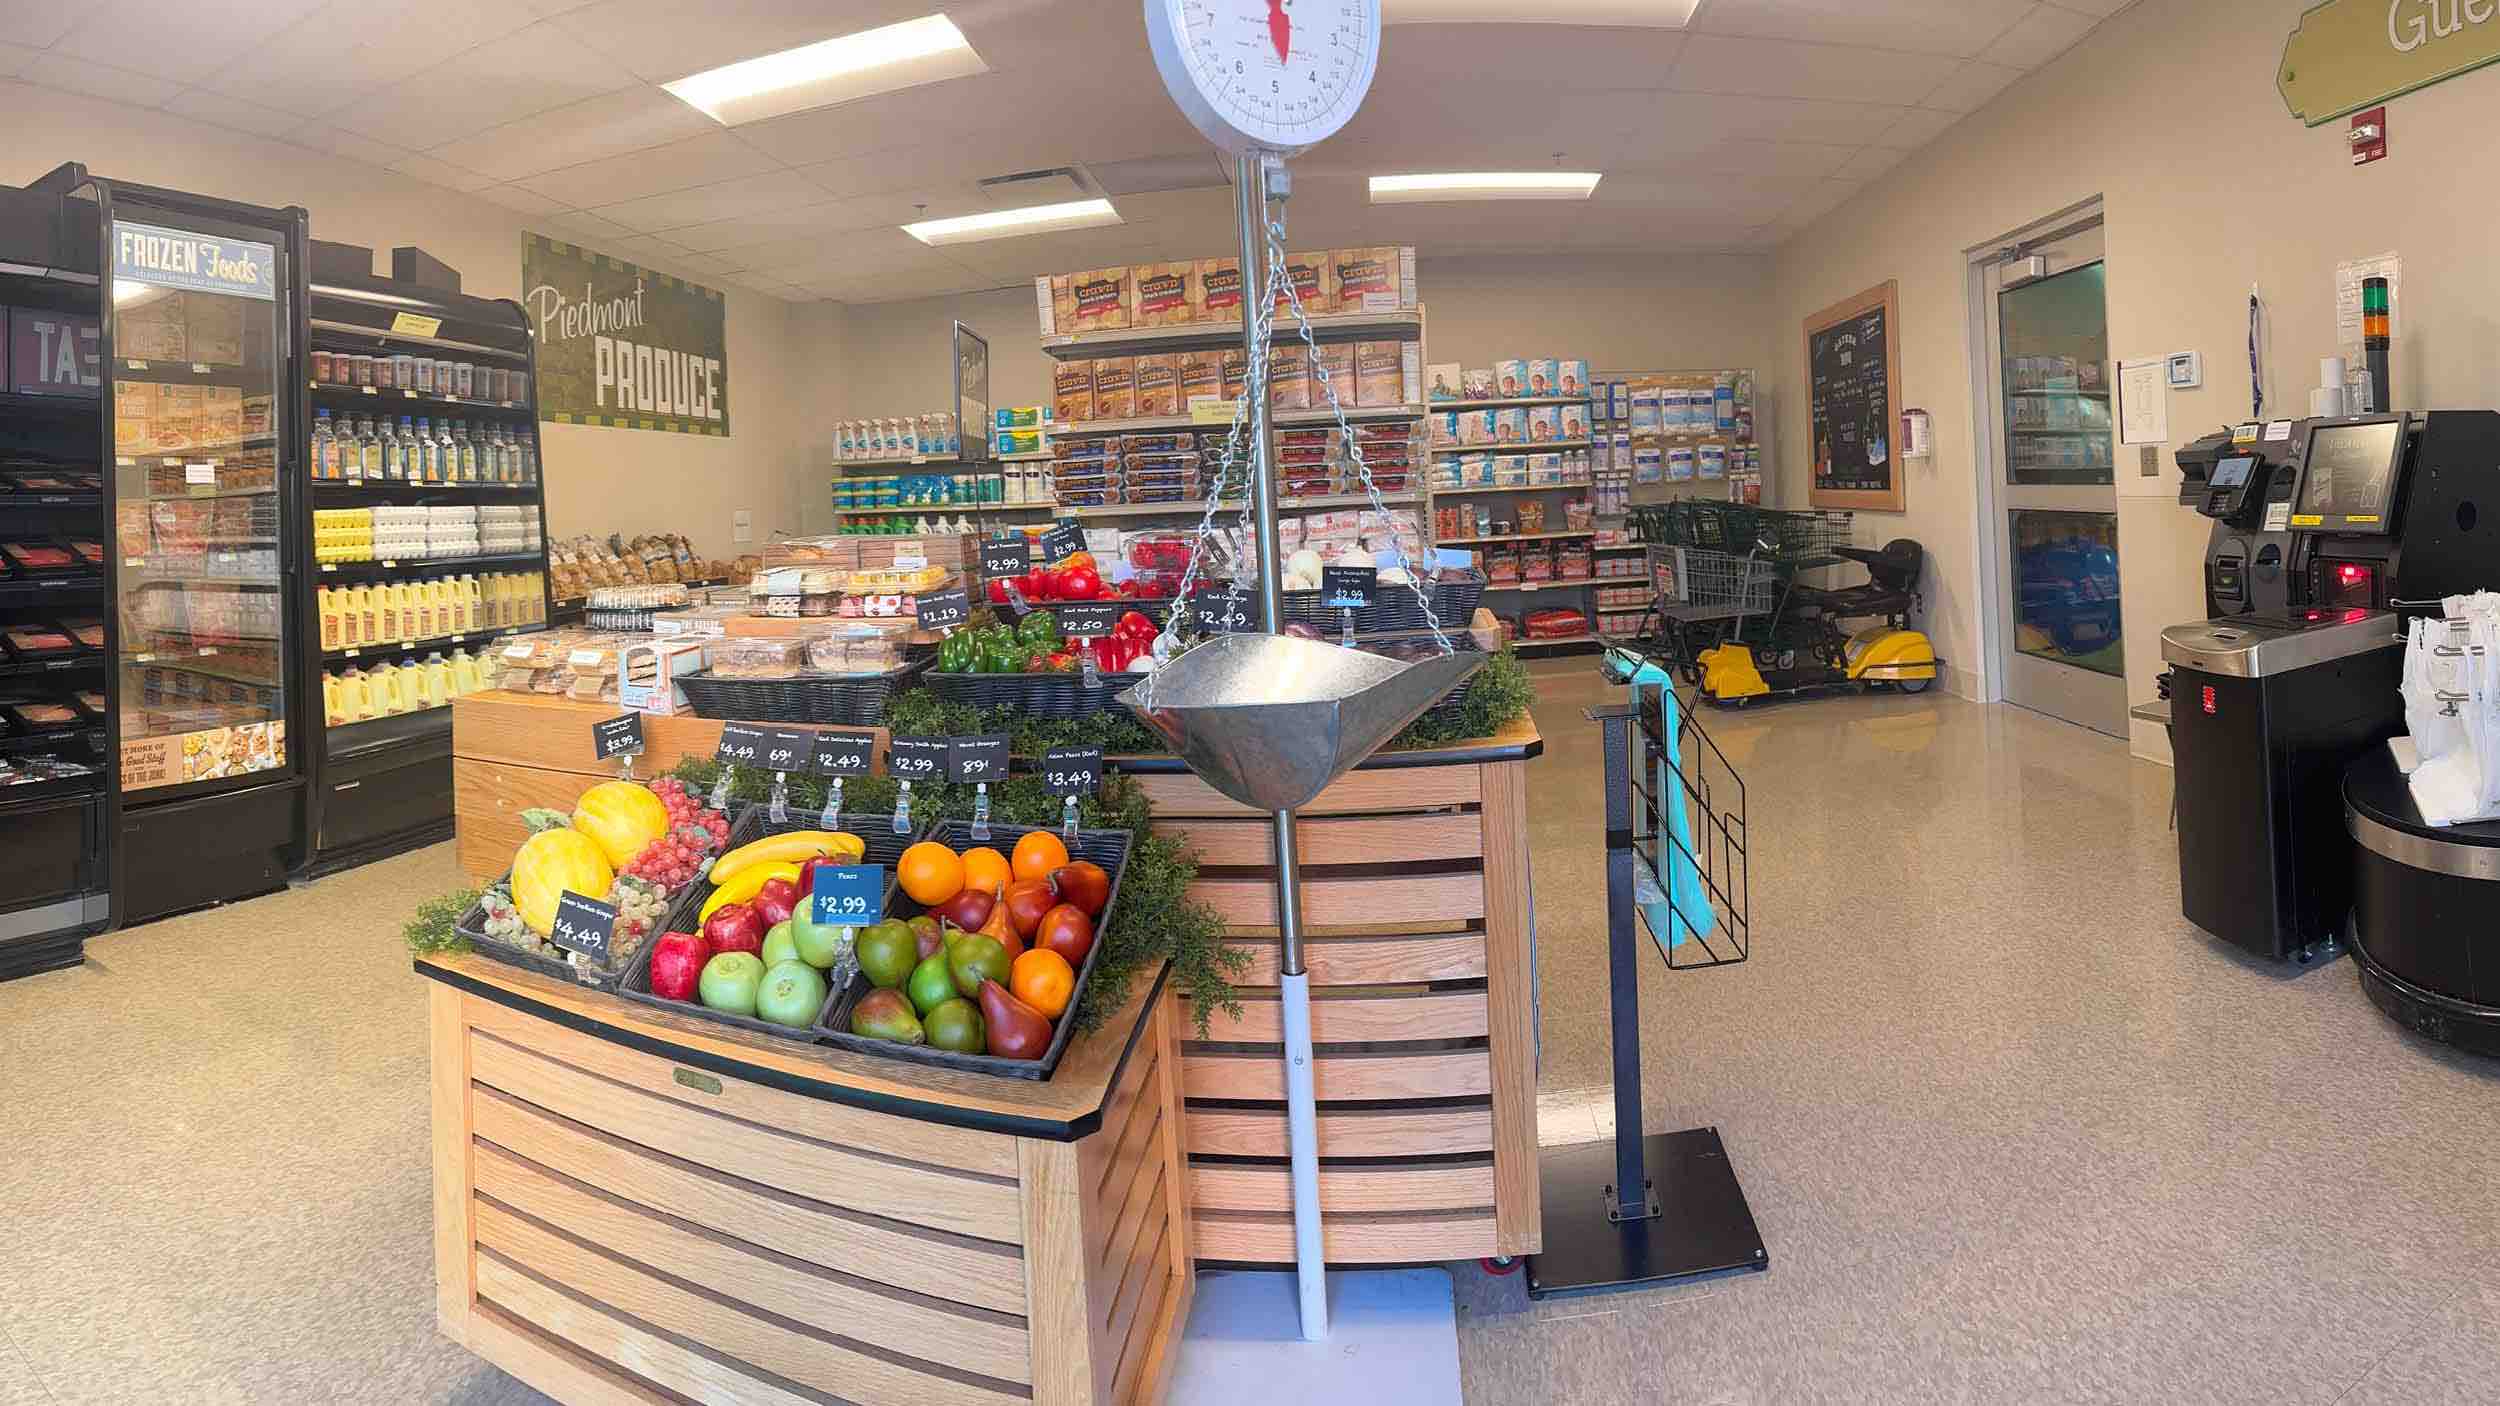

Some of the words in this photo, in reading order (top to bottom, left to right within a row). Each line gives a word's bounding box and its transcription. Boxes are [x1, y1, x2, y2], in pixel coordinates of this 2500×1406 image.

[1207, 12, 1216, 27] 7
[2388, 0, 2500, 51] Gue
[1329, 32, 1338, 47] 3
[1235, 60, 1244, 75] 6
[1308, 71, 1317, 83] 4
[1271, 80, 1280, 94] 5
[120, 232, 198, 273] FROZEN
[199, 243, 257, 284] Foods
[527, 278, 646, 345] Piedmont
[594, 335, 722, 420] PRODUCE
[986, 558, 1020, 571] $2.99
[923, 607, 958, 622] $1.19
[720, 742, 754, 759] $4.49
[818, 752, 861, 768] $2.49
[895, 757, 934, 771] $2.99
[1047, 769, 1092, 786] $3.49
[819, 895, 867, 914] $2.99
[556, 917, 602, 948] $4.49
